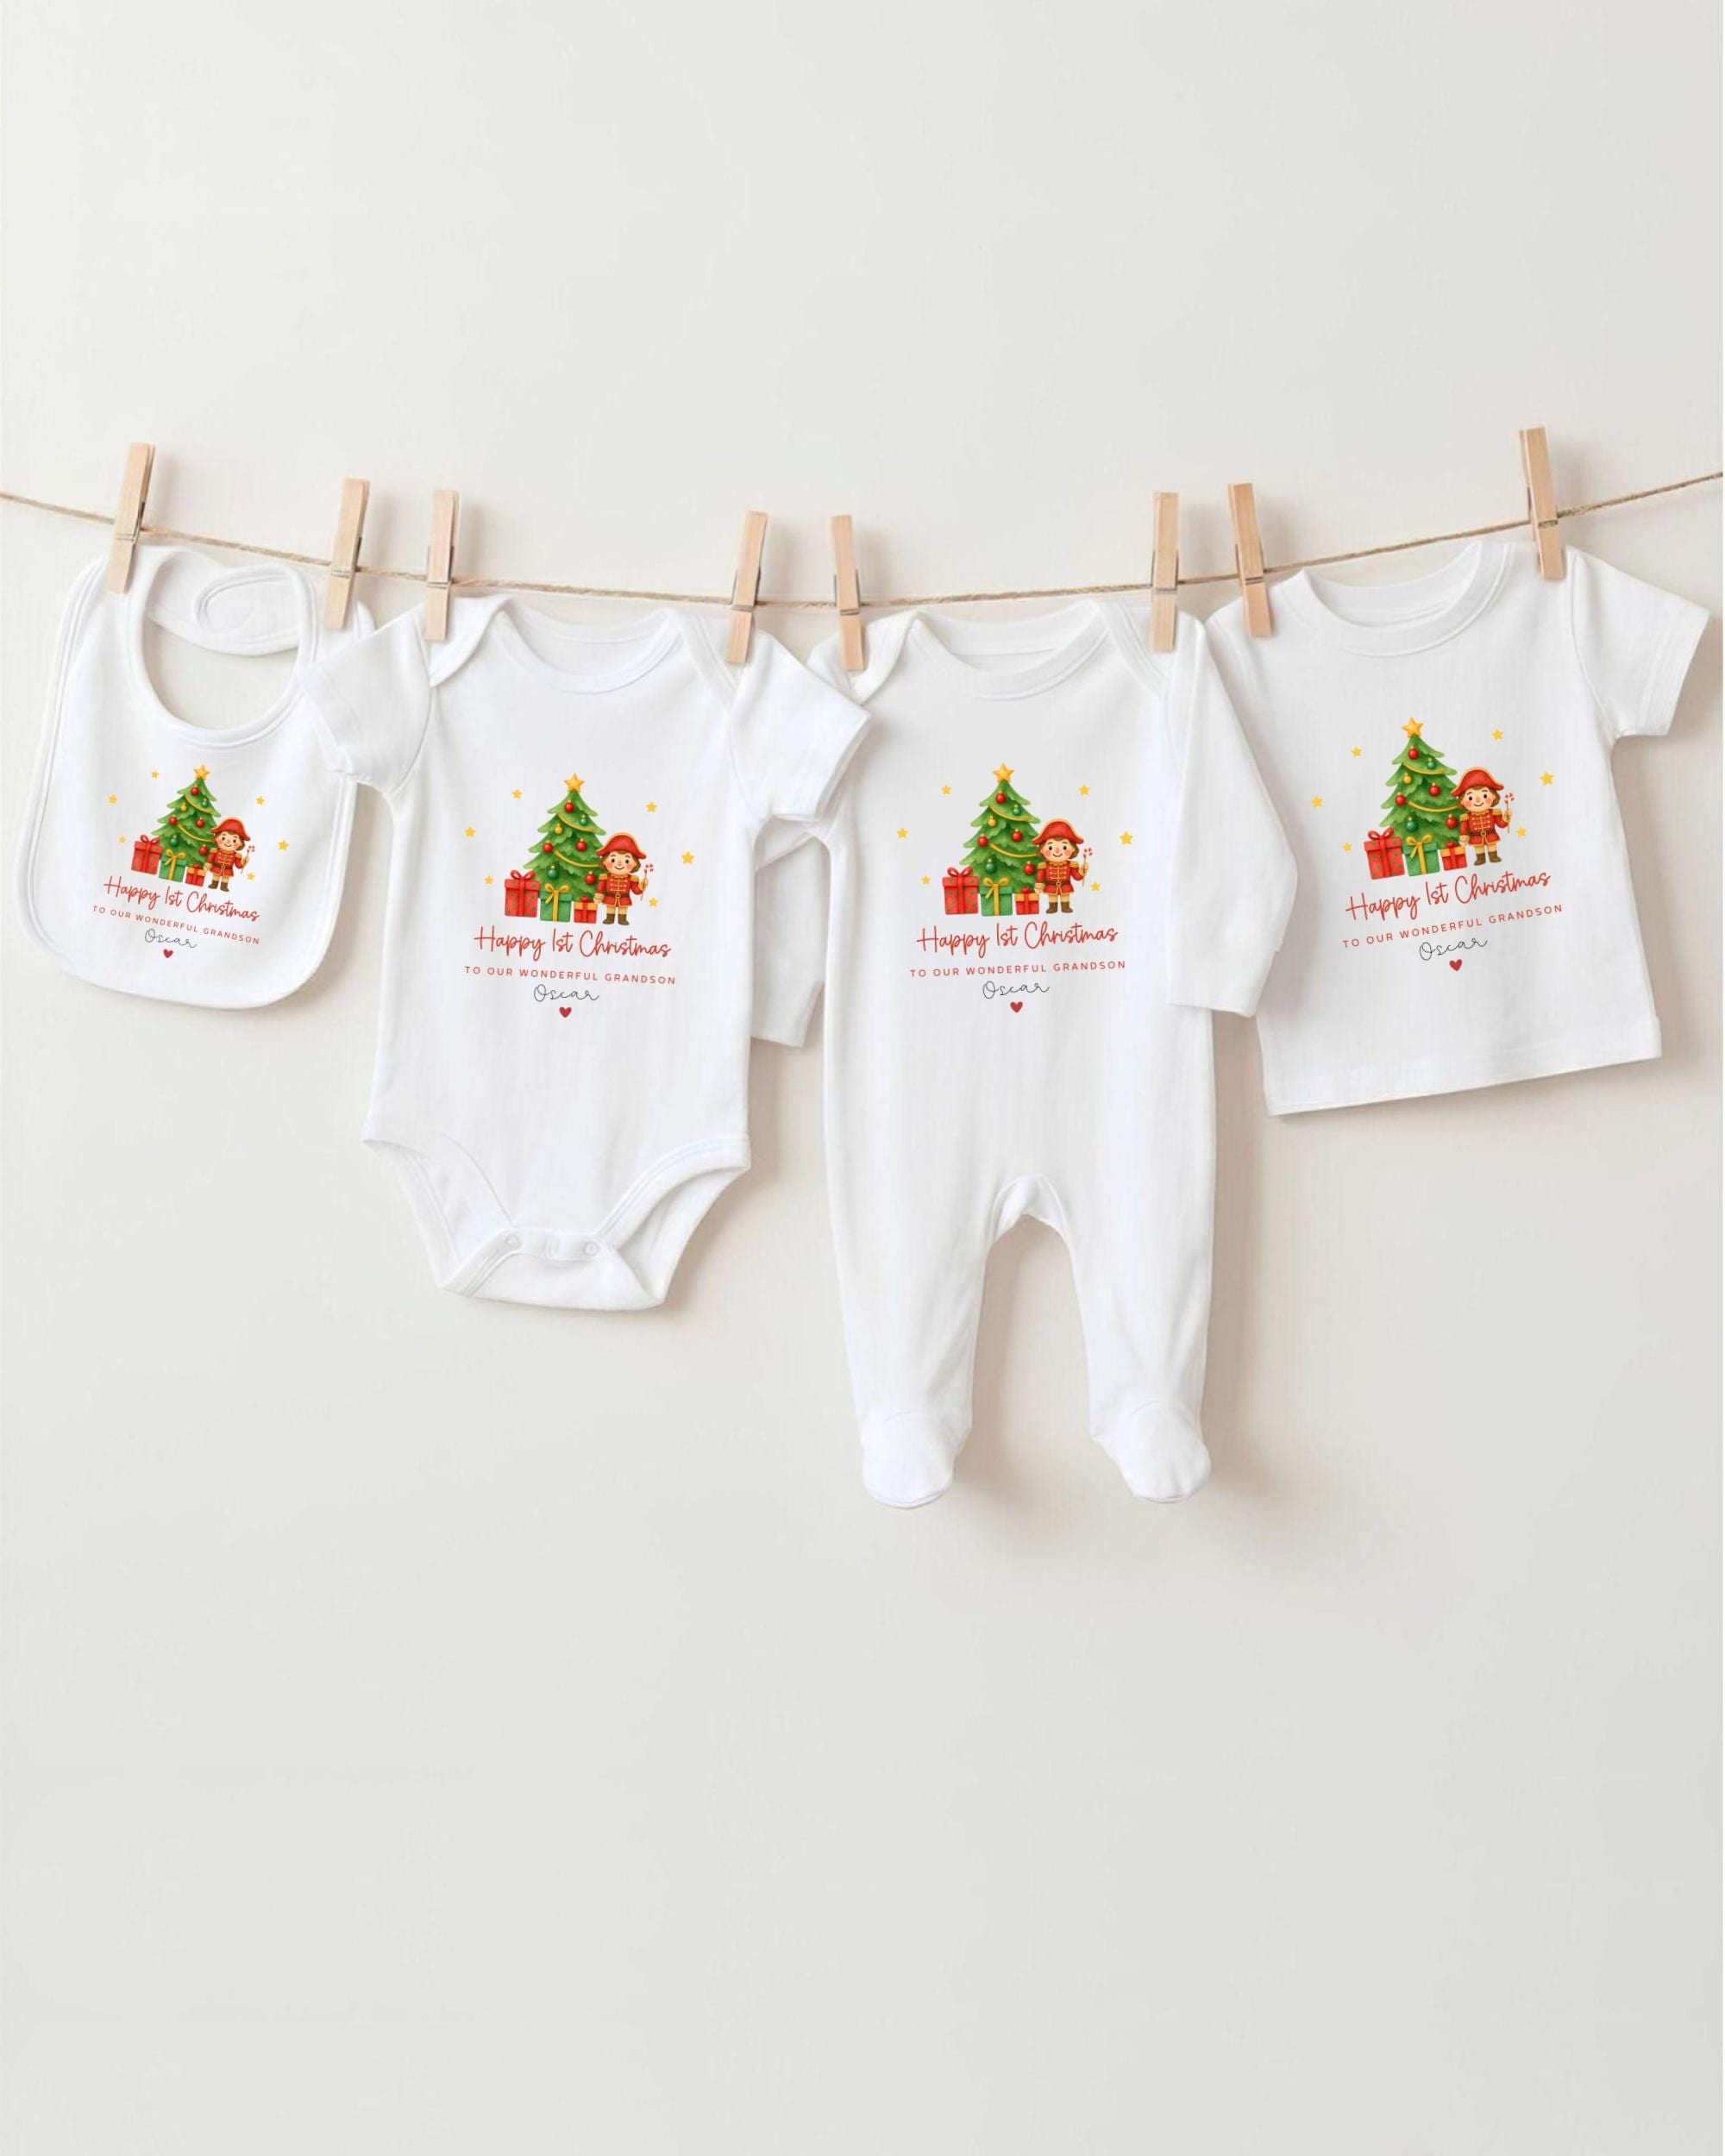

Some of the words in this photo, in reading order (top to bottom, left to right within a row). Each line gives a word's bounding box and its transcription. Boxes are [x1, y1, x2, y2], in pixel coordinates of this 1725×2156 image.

[104, 876, 160, 910] Happy
[186, 891, 260, 922] Christmas
[1346, 893, 1421, 921] Happy
[1455, 871, 1550, 904] Christmas
[93, 905, 106, 914] TO
[110, 909, 131, 919] OUR
[135, 914, 198, 933] WONDERFUL
[203, 927, 260, 945] GRANDSON
[145, 929, 198, 948] Oscar
[916, 925, 990, 958] Happy
[1025, 921, 1118, 949] Christmas
[1342, 938, 1360, 949] TO
[1365, 932, 1394, 945] OUR
[1399, 918, 1483, 939] WONDERFUL
[1488, 904, 1563, 924] GRANDSON
[474, 925, 546, 962] Happy
[580, 931, 671, 957] Christmas
[1420, 938, 1487, 961] Oscar
[464, 965, 481, 975] TO
[486, 967, 513, 976] OUR
[518, 968, 599, 981] WONDERFUL
[604, 973, 675, 985] GRANDSON
[910, 968, 927, 978] TO
[932, 967, 960, 977] OUR
[965, 964, 1047, 975] WONDERFUL
[1052, 960, 1126, 972] GRANDSON
[534, 984, 599, 1002] Oscar
[982, 981, 1050, 999] Oscar
